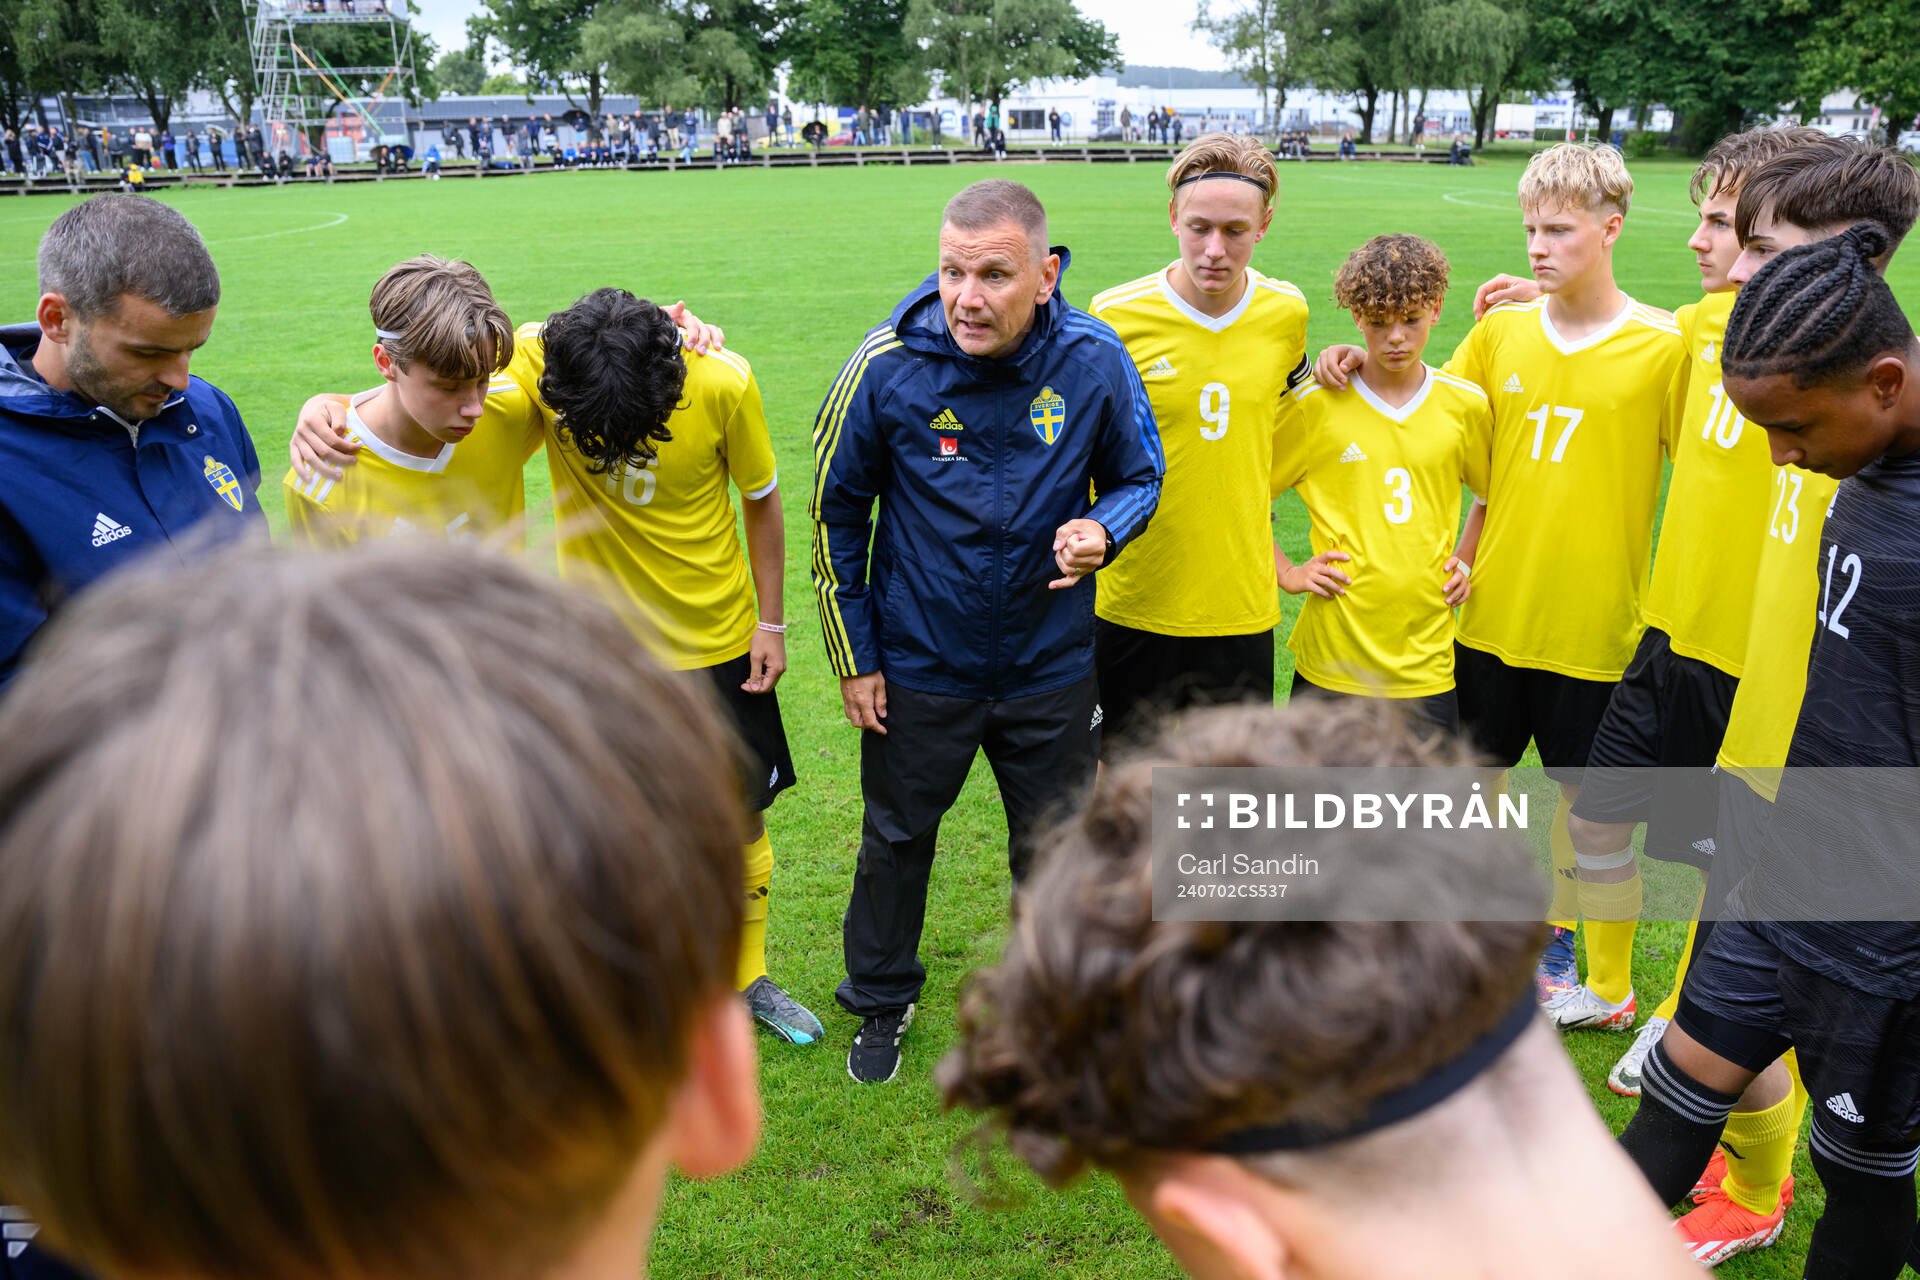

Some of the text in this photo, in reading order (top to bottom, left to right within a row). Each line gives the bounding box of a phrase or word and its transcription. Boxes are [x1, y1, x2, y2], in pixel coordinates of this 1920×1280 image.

[1147, 367, 1177, 377] adidas
[930, 421, 964, 431] adidas
[1199, 382, 1230, 441] 9
[1526, 403, 1584, 463] 17
[1702, 383, 1745, 449] 10
[1384, 467, 1412, 524] 3
[1769, 468, 1804, 544] 23
[91, 525, 133, 547] adidas
[1818, 544, 1862, 640] 12
[1826, 1099, 1865, 1123] adidas
